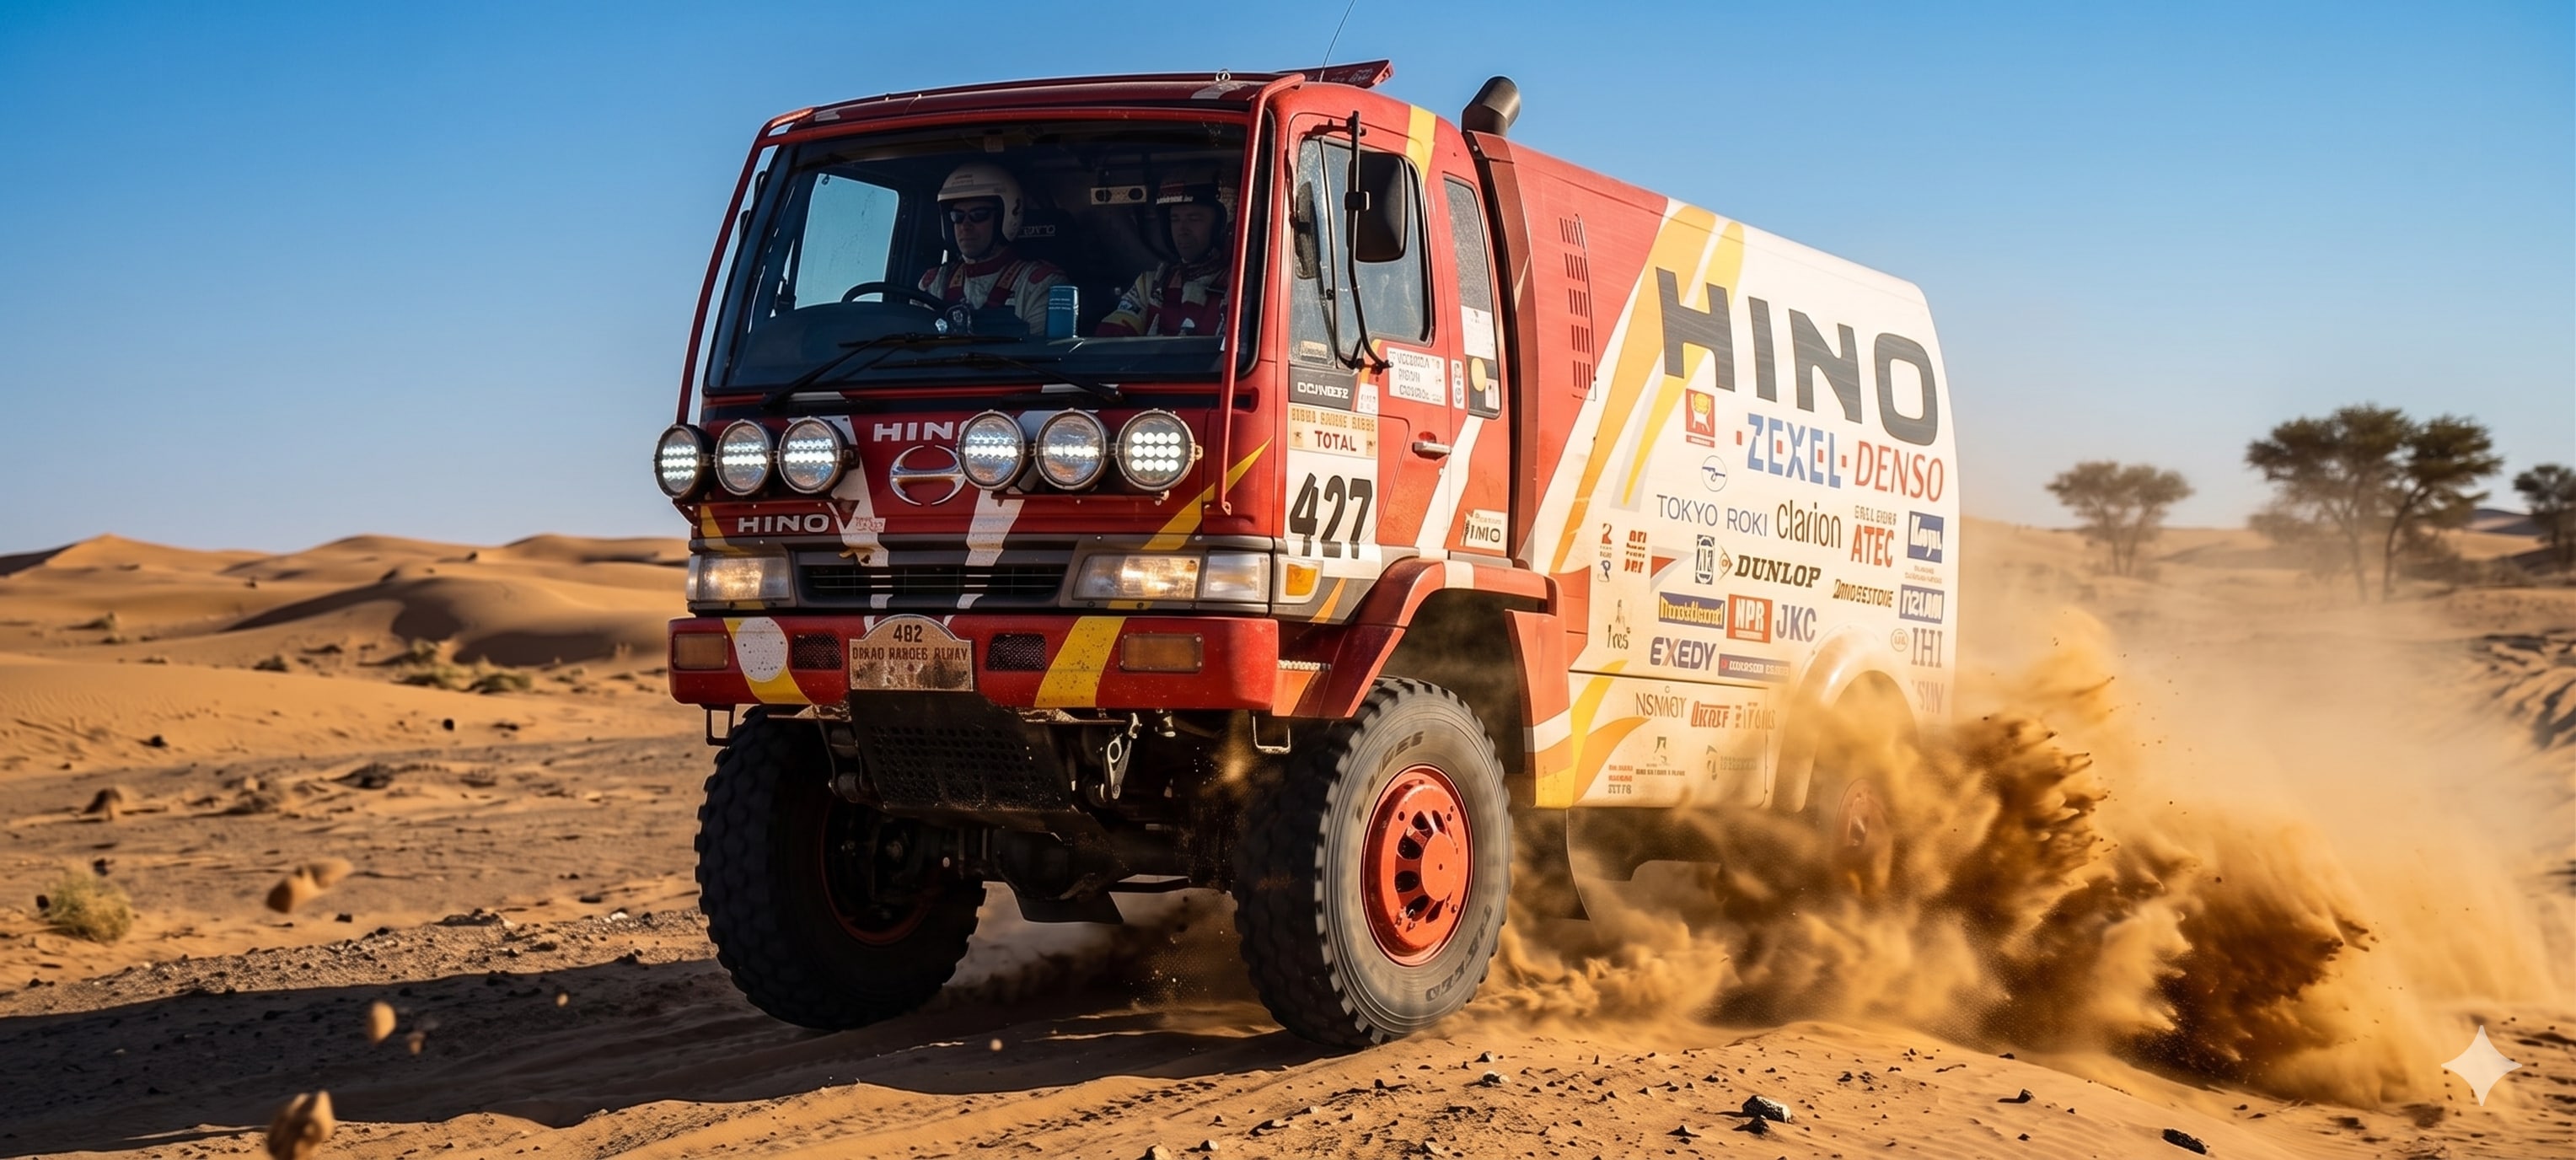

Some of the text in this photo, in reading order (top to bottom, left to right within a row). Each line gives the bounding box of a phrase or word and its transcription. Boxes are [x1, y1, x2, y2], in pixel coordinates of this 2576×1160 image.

[1656, 266, 1938, 446] HINO
[873, 421, 969, 442] HIN
[1314, 430, 1357, 452] TOTAL
[1747, 412, 1841, 489] ZEXEL
[1854, 441, 1944, 502] DENSO
[738, 513, 829, 533] HINO
[1290, 472, 1373, 559] 427
[1656, 494, 1768, 537] TOKYO ROKI
[1776, 499, 1842, 549] Clarion
[1850, 524, 1895, 567] ATEC
[1734, 554, 1822, 588] DUNLOP
[894, 624, 923, 642] 482
[1735, 597, 1765, 632] NPR
[1776, 604, 1817, 643] JKC
[1650, 636, 1717, 671] EXEDY
[1911, 626, 1943, 669] IHI
